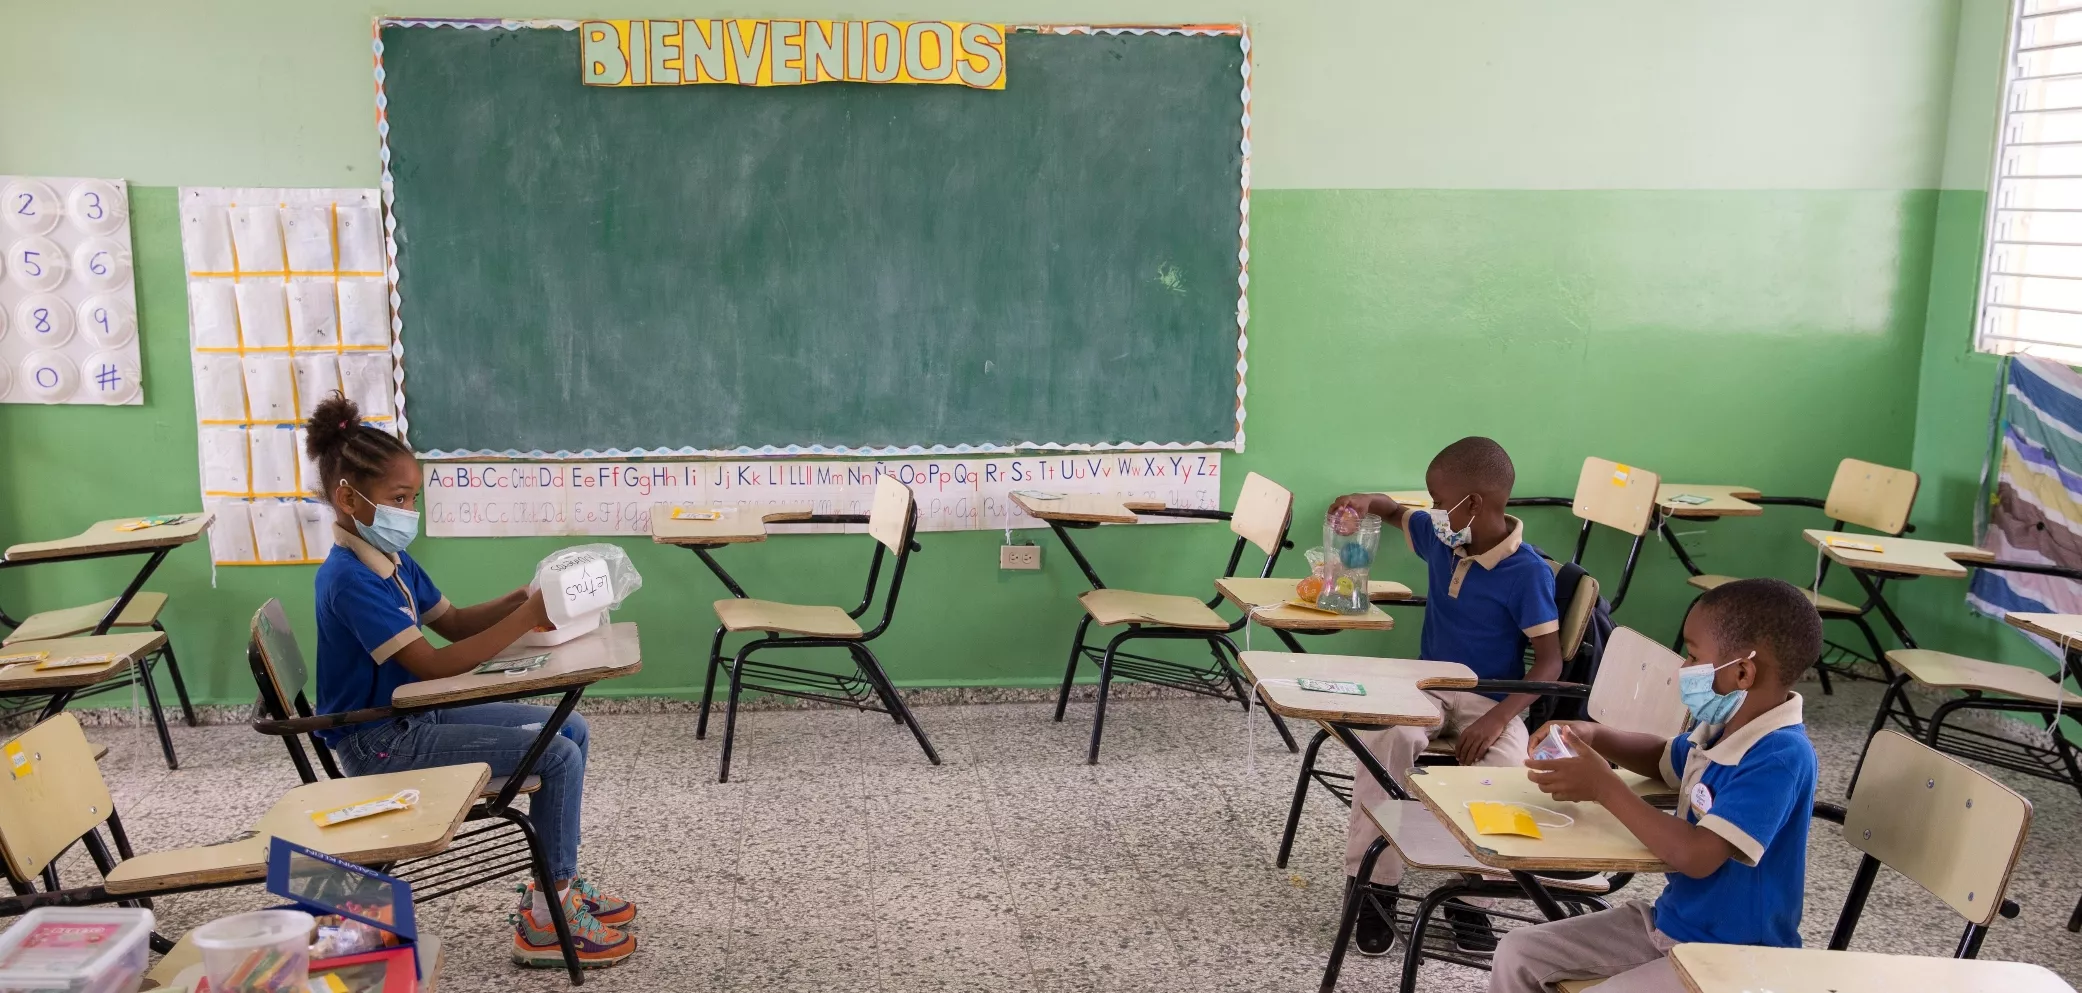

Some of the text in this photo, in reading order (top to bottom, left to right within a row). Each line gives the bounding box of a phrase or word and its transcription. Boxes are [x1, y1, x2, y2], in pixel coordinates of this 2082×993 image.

[582, 19, 1003, 88] BIENVENIDOS
[18, 192, 104, 220] 2 3
[24, 251, 108, 277] 5 6
[33, 308, 109, 334] 8 9
[95, 363, 122, 391] #
[428, 467, 454, 488] Aa
[456, 467, 482, 488] Bb
[482, 467, 509, 488] Cc
[539, 467, 564, 488] Dd
[572, 467, 595, 488] Ee
[599, 466, 620, 488] Ff
[623, 466, 651, 496] Gg
[652, 466, 677, 487] Hh
[738, 466, 761, 486] Kk
[817, 466, 843, 485] Mm
[848, 466, 872, 486] Nn
[899, 464, 926, 485] Oo
[929, 464, 951, 492] Pp
[954, 463, 978, 492] Qq
[985, 463, 1005, 483] Rr
[1011, 461, 1032, 482] Ss
[1039, 460, 1055, 480] Tt
[1061, 459, 1085, 480] Uu
[1087, 458, 1111, 478] Vv
[1117, 457, 1141, 477] Ww
[1144, 457, 1165, 477] Xx
[1169, 456, 1192, 484] Yy
[1197, 456, 1217, 477] Zz
[304, 848, 379, 877] CALVIN KLEIN
